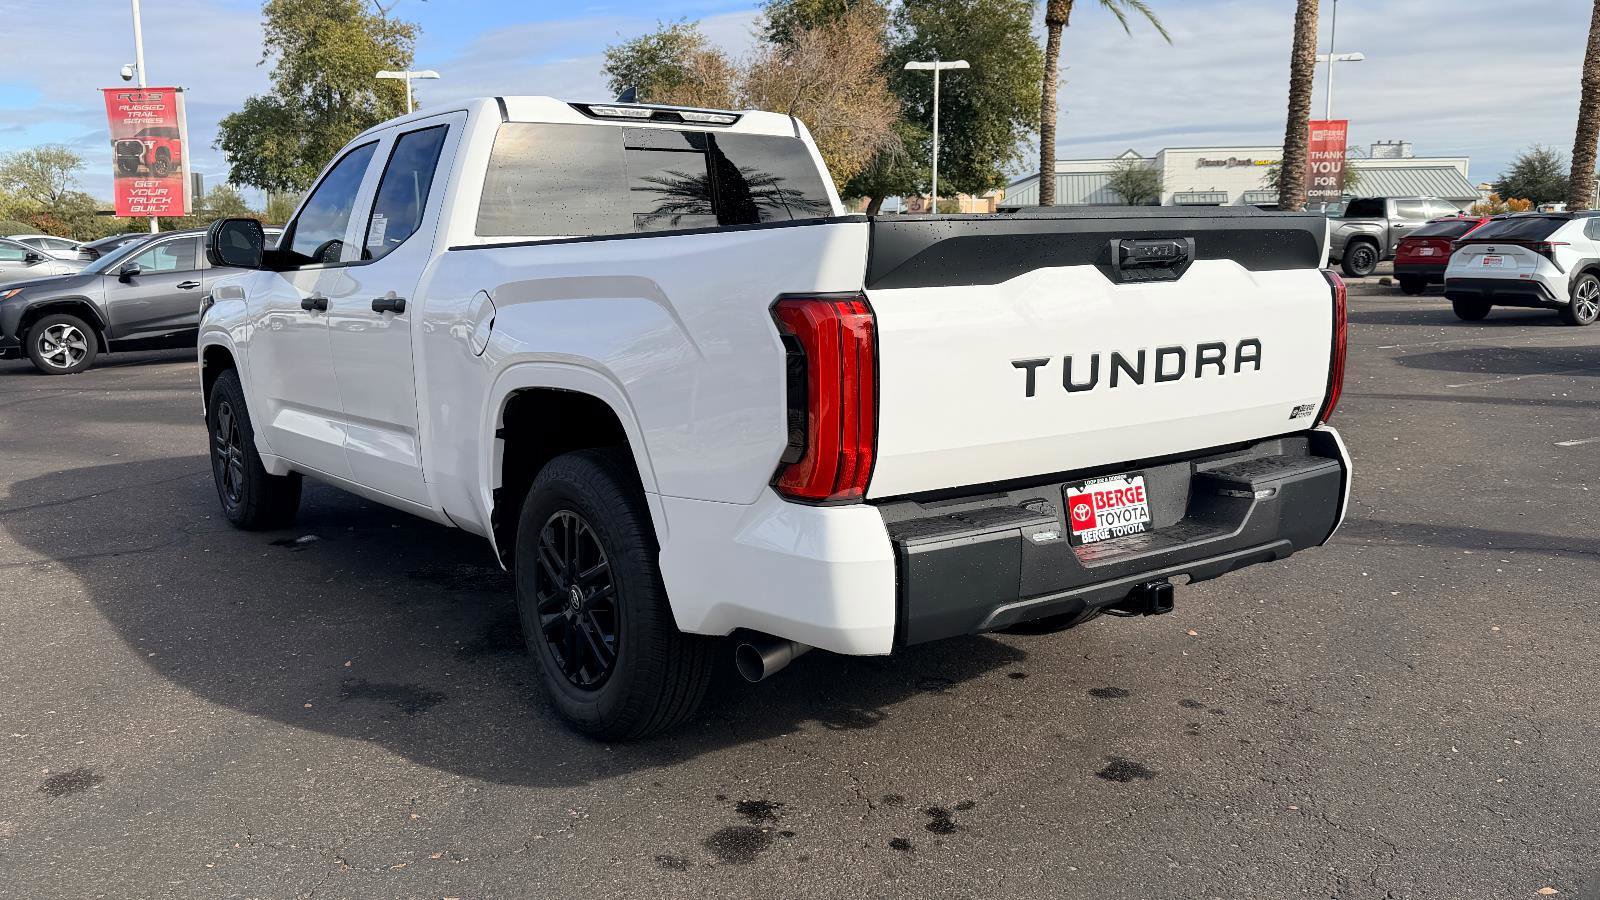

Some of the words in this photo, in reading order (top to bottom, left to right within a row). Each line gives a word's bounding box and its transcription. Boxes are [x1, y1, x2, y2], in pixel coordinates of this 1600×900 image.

[1311, 151, 1343, 159] THANK
[1311, 162, 1341, 173] YOU
[1314, 177, 1336, 186] FOR
[1011, 337, 1262, 397] TUNDRA
[1094, 486, 1144, 509] BERGE
[1097, 507, 1148, 526] TOYOTA
[1081, 529, 1110, 543] BERGE
[1112, 523, 1145, 537] TOYOTA
